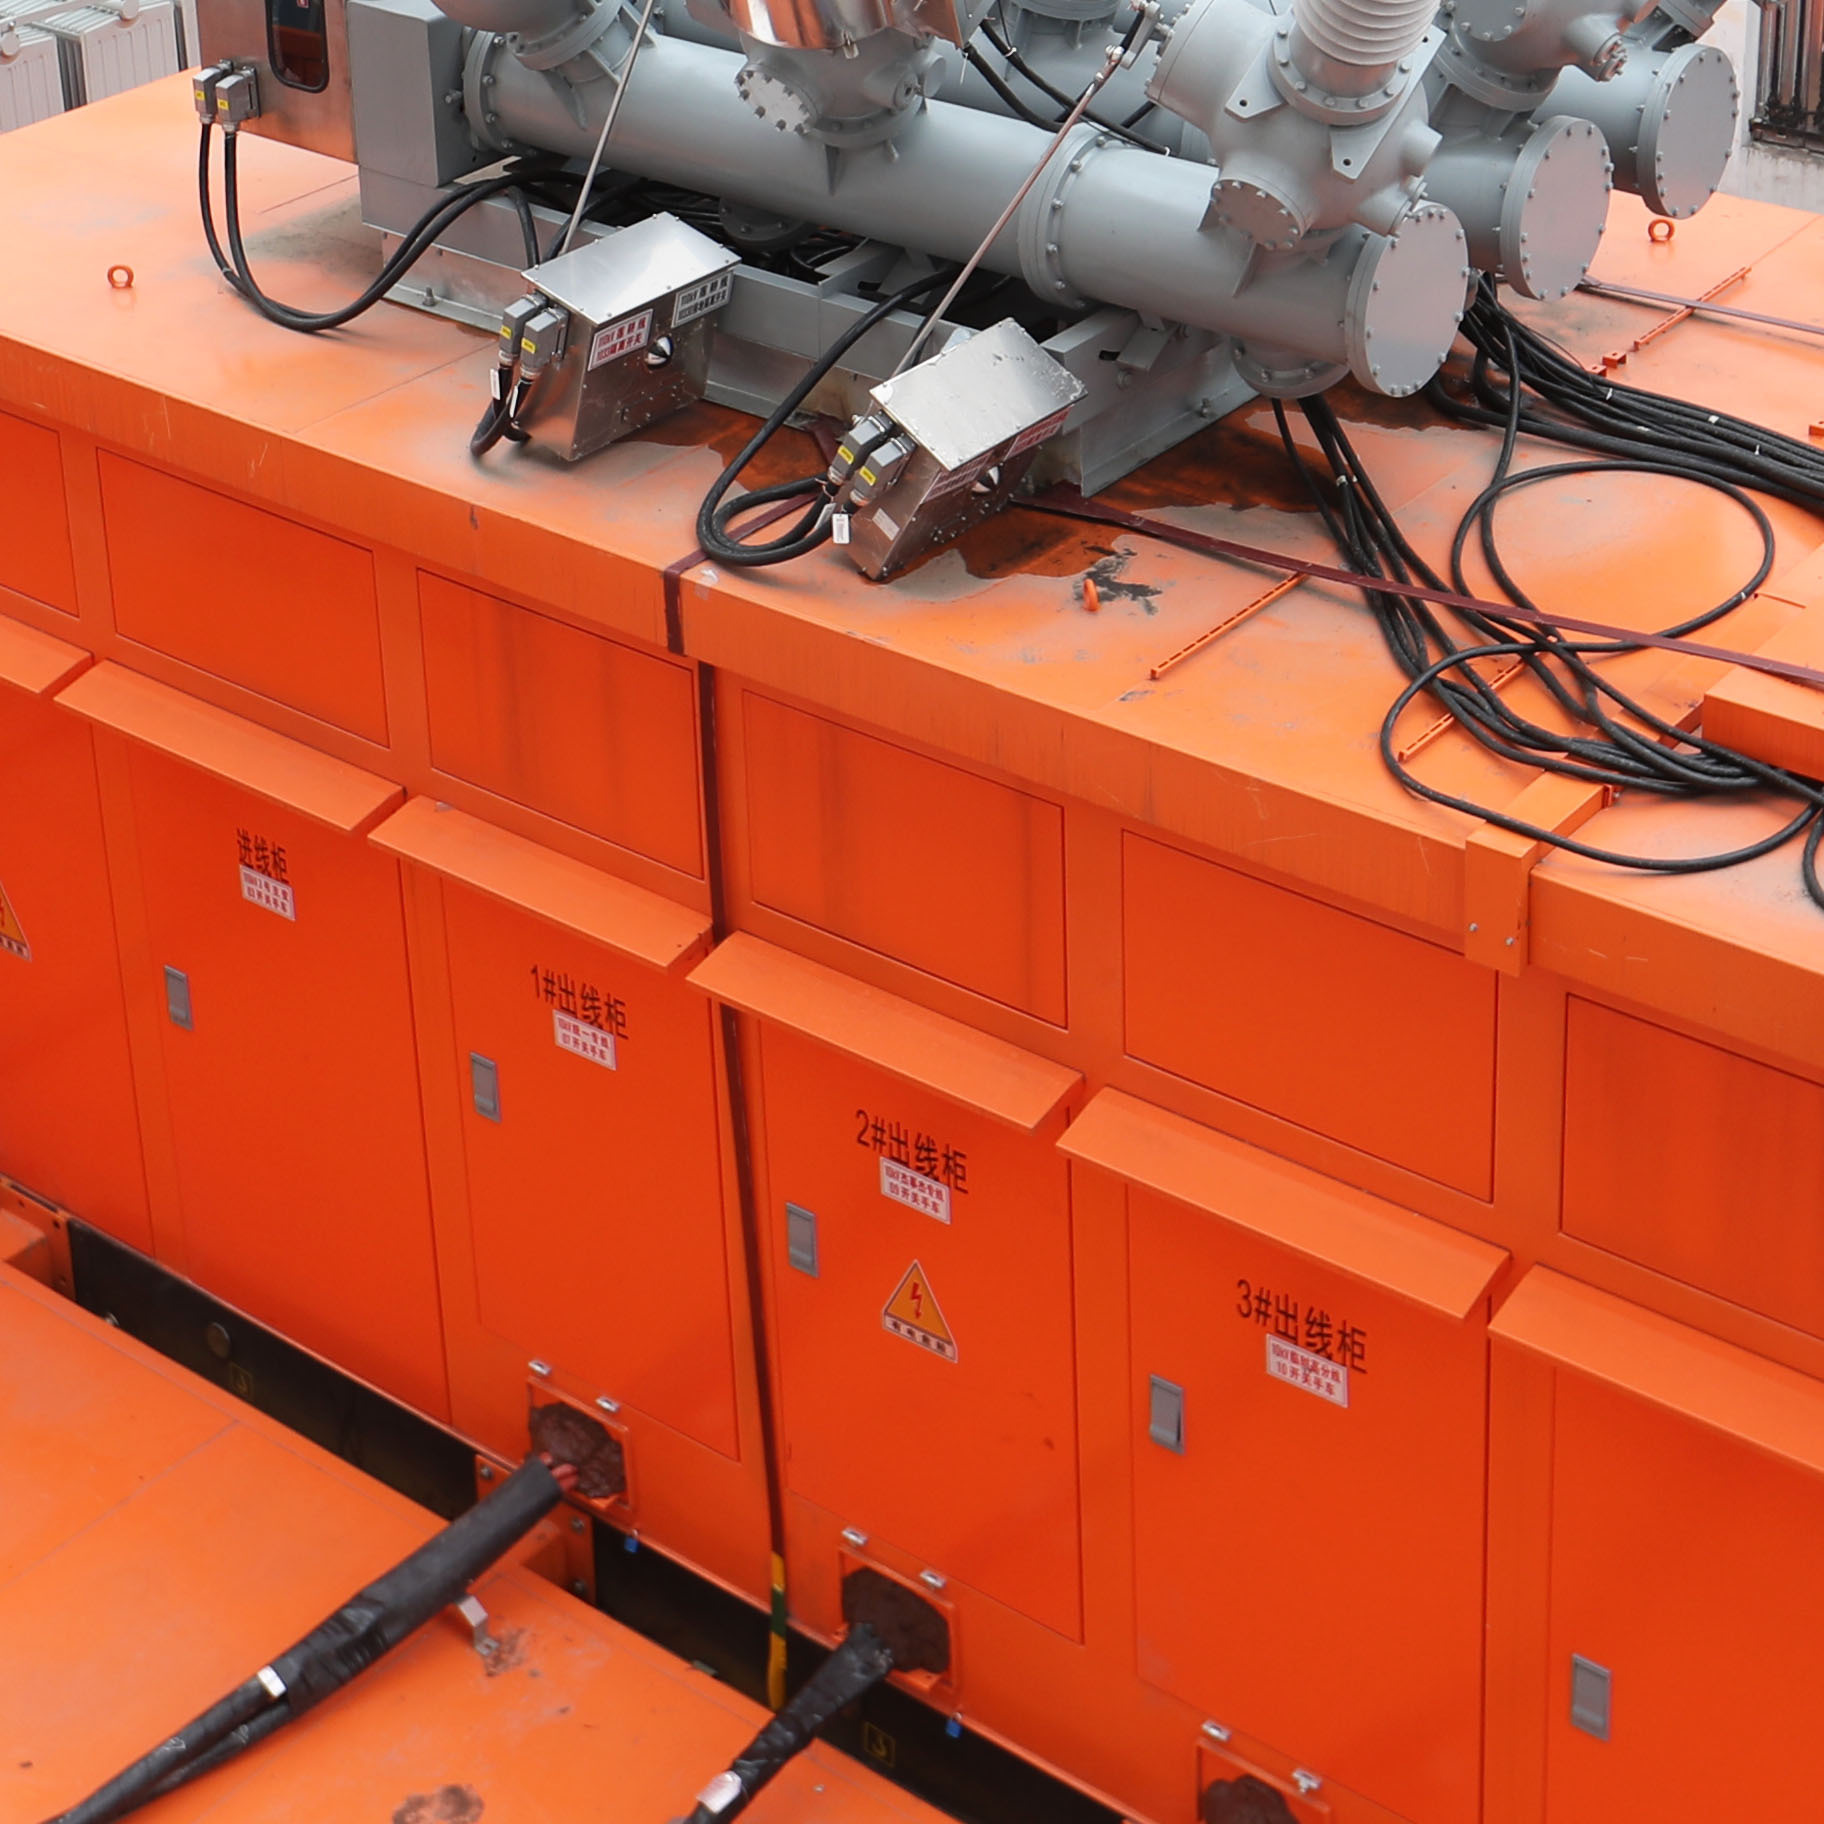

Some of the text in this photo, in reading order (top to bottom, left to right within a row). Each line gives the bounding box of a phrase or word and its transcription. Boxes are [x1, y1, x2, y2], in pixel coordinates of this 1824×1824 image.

[237, 828, 289, 884] 进线柜
[531, 964, 628, 1040] 1#出线柜
[856, 1109, 968, 1194] 2#出线柜
[1237, 1279, 1368, 1374] 3#出线柜
